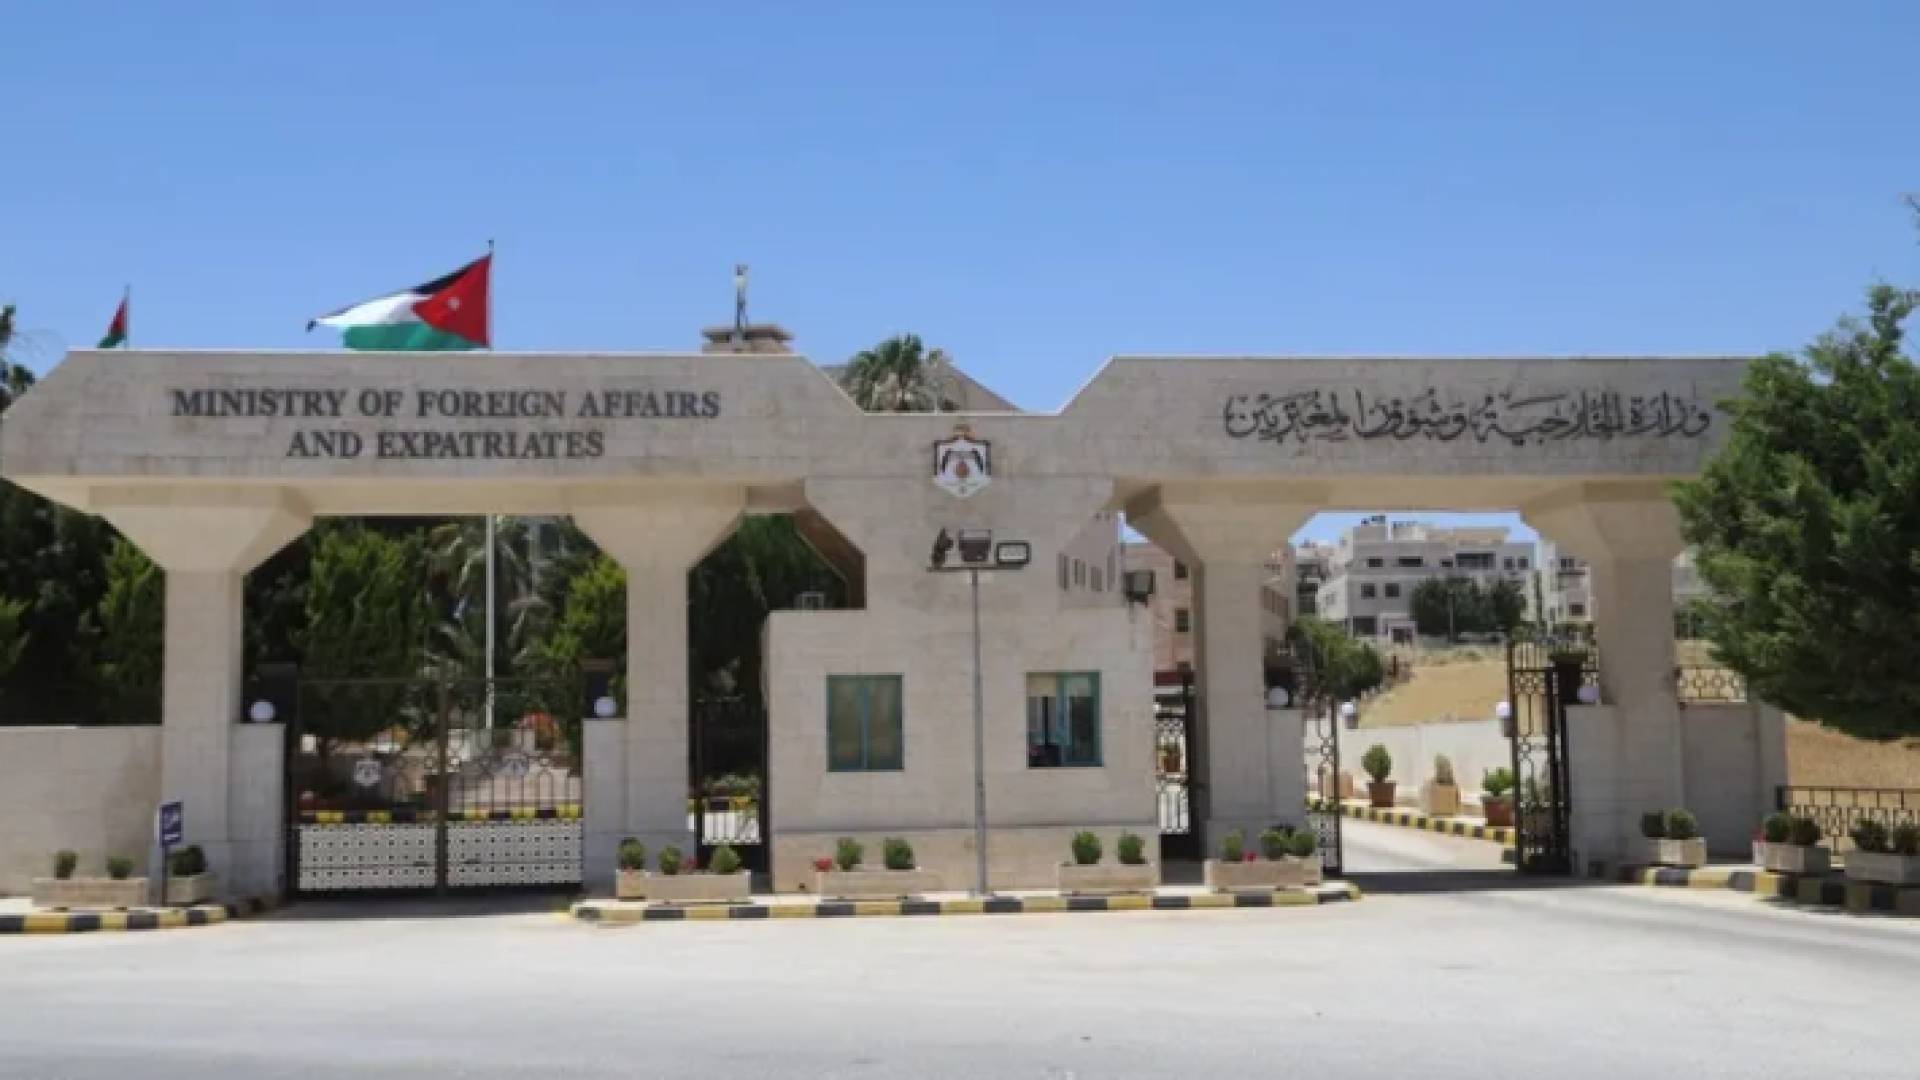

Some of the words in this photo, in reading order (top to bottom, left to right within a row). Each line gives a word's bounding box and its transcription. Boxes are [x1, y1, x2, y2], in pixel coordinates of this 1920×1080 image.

[171, 389, 347, 417] MINISTRY
[358, 389, 403, 417] OF
[416, 389, 567, 417] FOREIGN
[577, 389, 721, 418] AFFAIRS
[1224, 388, 1365, 443] المغتربين
[1470, 390, 1624, 446] الخارجية
[1625, 389, 1711, 439] وزارة
[286, 431, 363, 457] AND
[377, 431, 605, 458] EXPATRIATES
